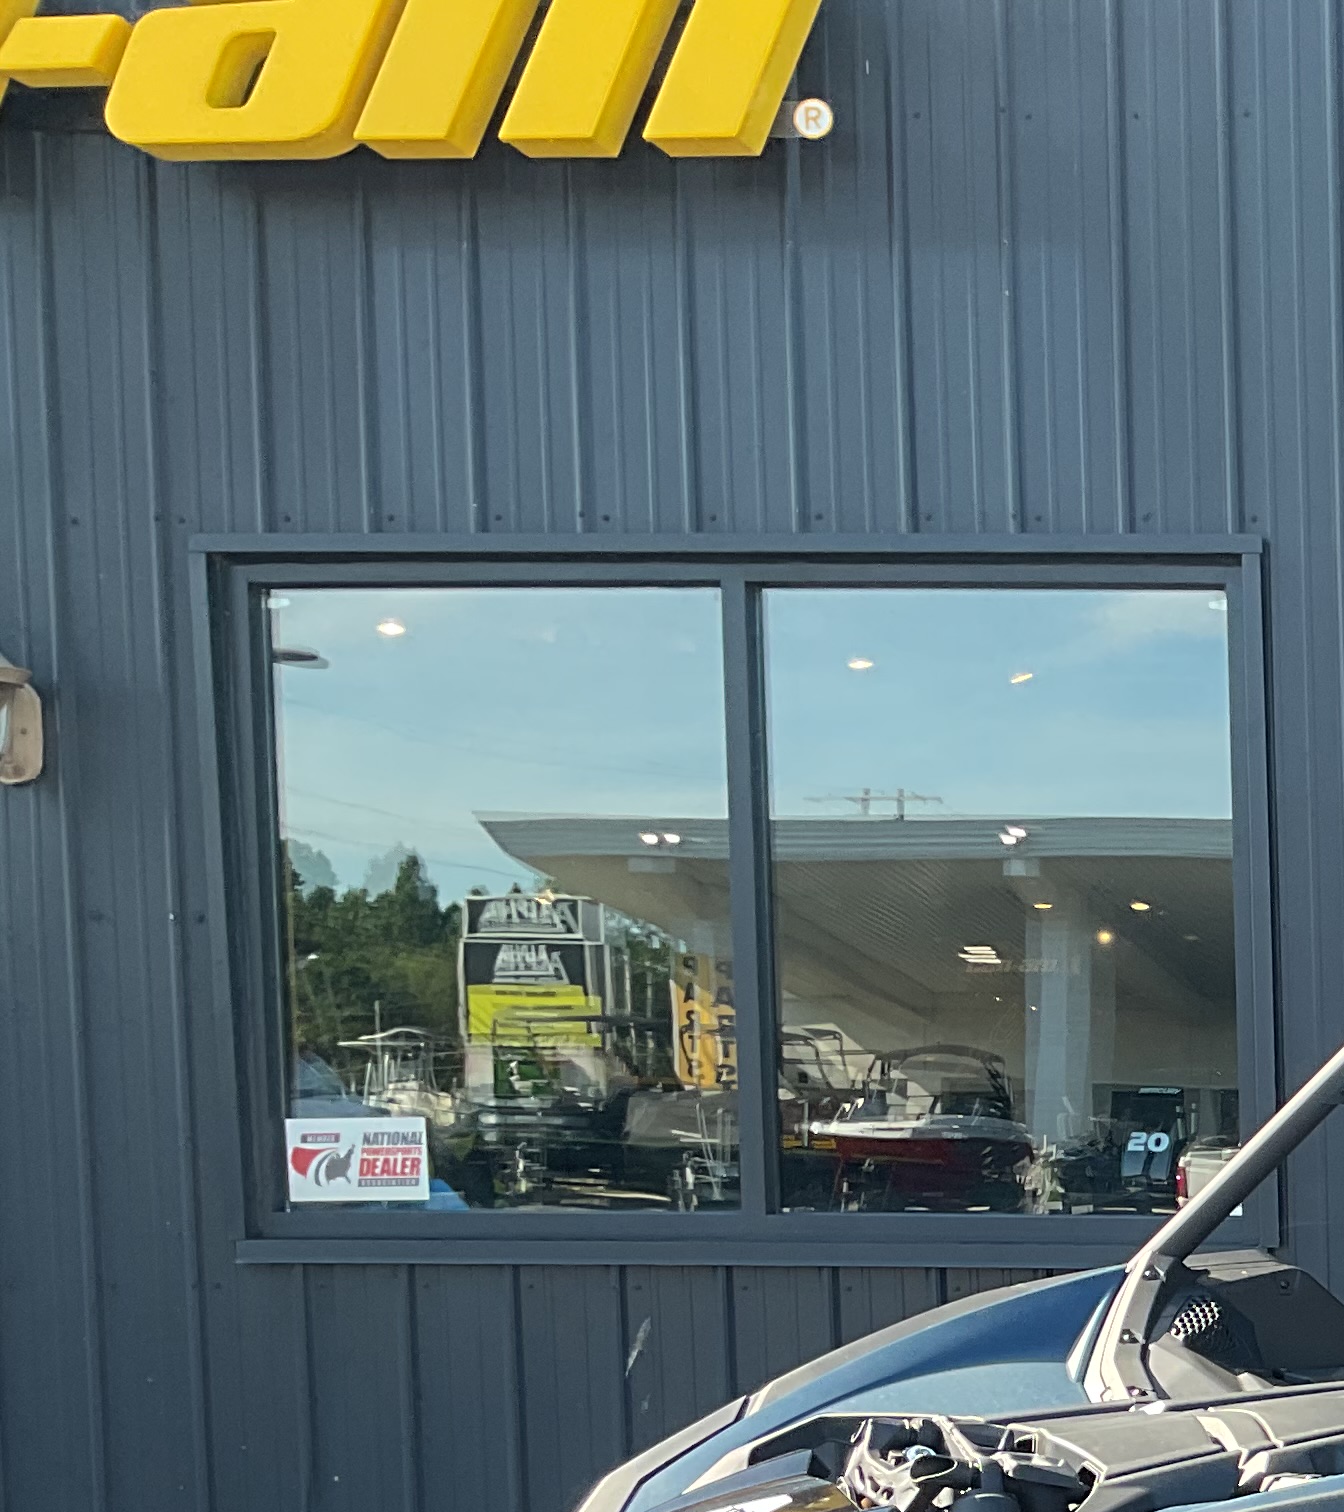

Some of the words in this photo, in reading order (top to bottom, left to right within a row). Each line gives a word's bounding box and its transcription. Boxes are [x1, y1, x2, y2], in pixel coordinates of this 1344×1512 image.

[362, 1131, 424, 1146] NATIONAL
[1127, 1131, 1171, 1153] 20
[359, 1158, 421, 1177] DEALER
